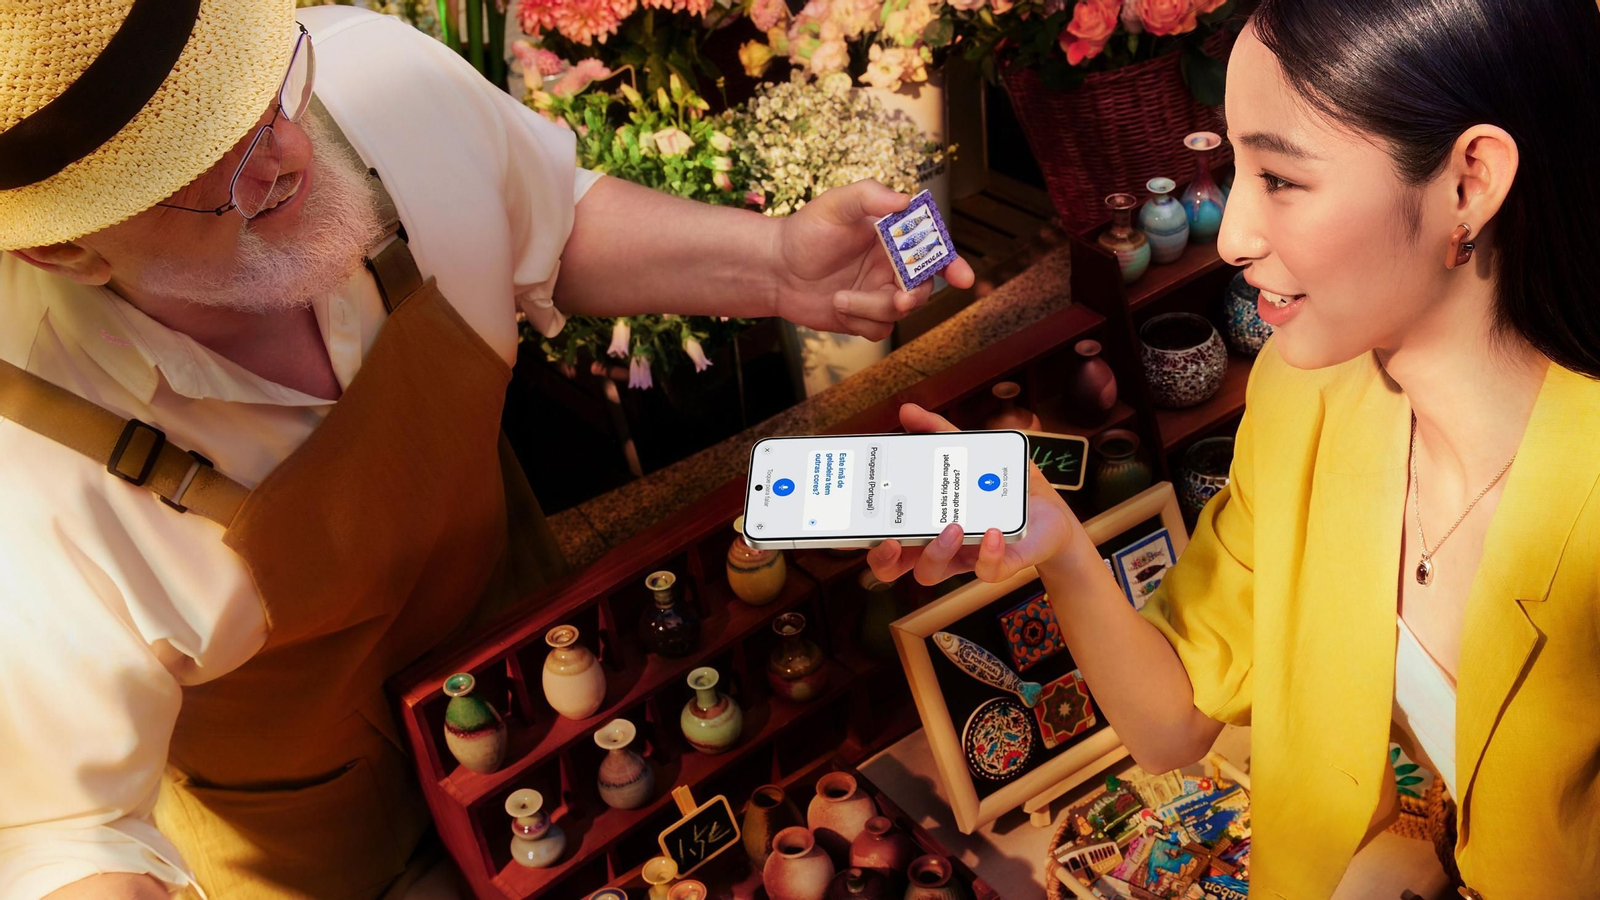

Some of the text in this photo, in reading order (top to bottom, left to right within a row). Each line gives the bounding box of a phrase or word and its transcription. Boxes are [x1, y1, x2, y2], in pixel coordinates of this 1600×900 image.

[913, 250, 943, 273] PORTUGAL
[812, 453, 822, 496] outras cores?
[824, 452, 834, 496] geladeira tem
[837, 480, 845, 488] de
[866, 447, 877, 511] Portuguese (Portugal)
[940, 453, 951, 523] Does this fridge magnet
[894, 501, 904, 524] English
[952, 469, 961, 523] have other colors?
[971, 656, 999, 675] PORTUGAL
